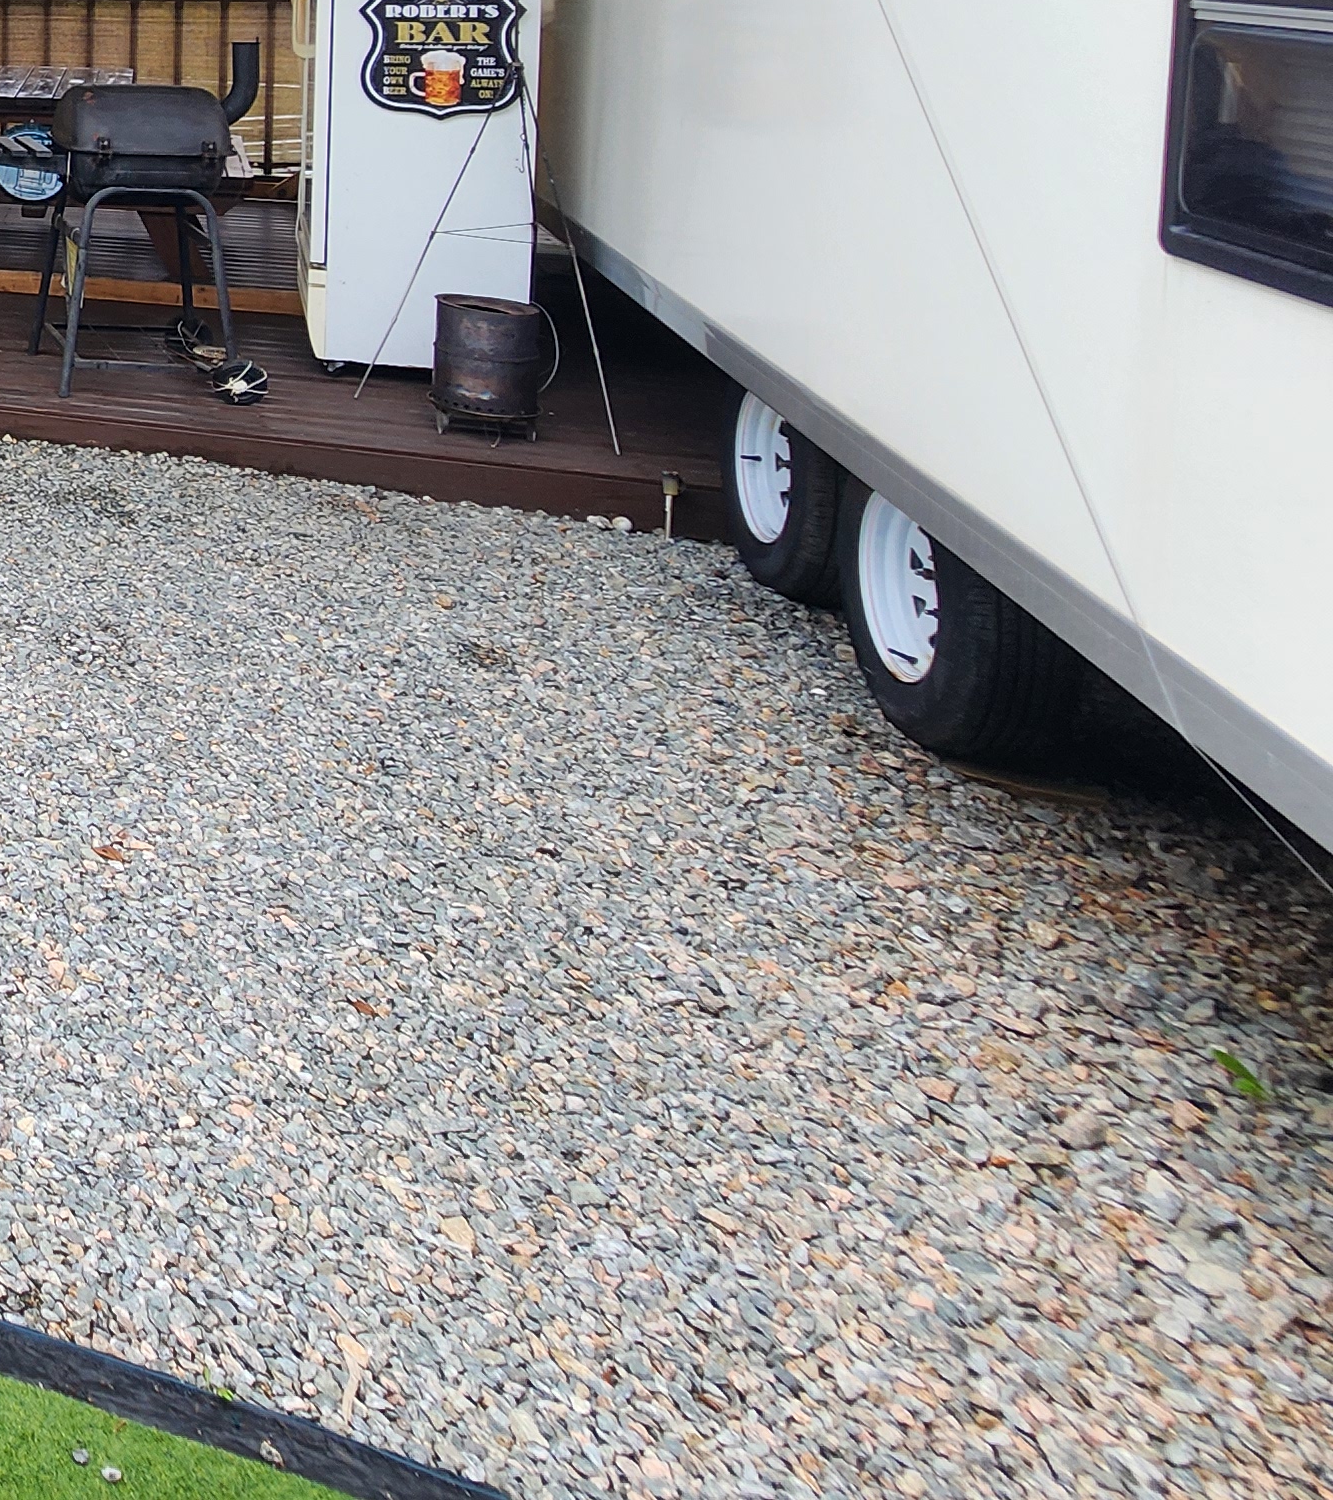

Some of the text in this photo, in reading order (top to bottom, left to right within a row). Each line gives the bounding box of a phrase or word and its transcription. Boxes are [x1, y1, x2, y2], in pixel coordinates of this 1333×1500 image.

[385, 4, 500, 18] ROBERT'S
[394, 21, 493, 44] BAR
[383, 54, 412, 64] BRING
[476, 56, 497, 66] THE
[383, 66, 408, 75] YOUR
[470, 67, 505, 77] GAME'S
[383, 76, 403, 85] OWN
[383, 86, 408, 95] BEER
